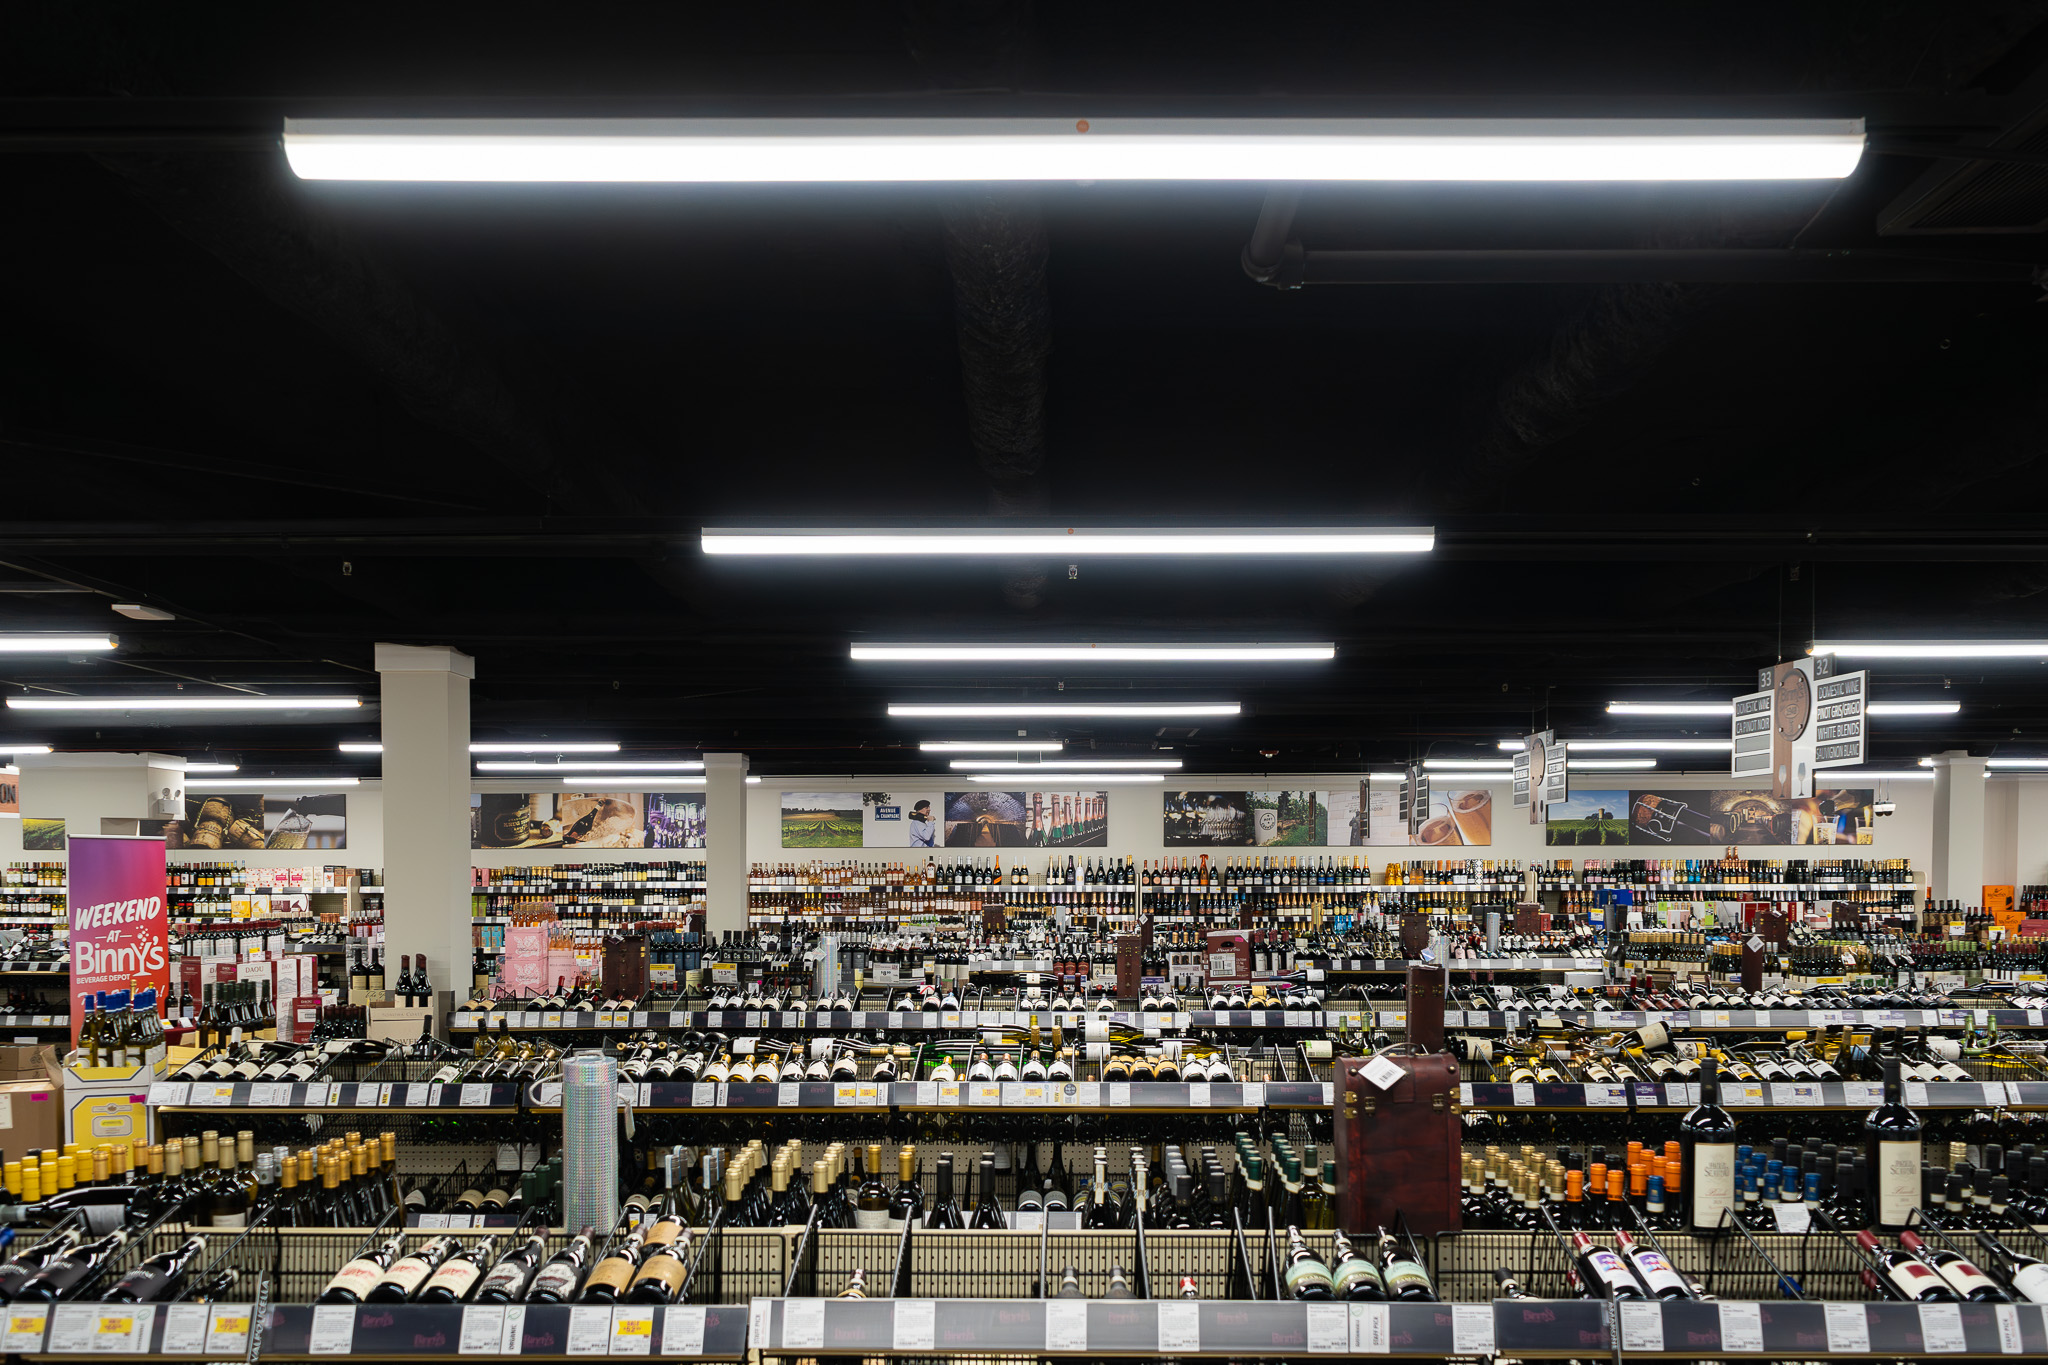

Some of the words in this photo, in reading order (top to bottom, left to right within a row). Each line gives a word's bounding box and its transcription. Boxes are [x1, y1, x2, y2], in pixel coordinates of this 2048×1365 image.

[1816, 658, 1828, 676] 32
[1761, 671, 1771, 688] 33
[1818, 683, 1844, 700] DOMESTIC
[1845, 679, 1860, 694] WINE
[1736, 700, 1758, 715] DOMESTIC
[1758, 697, 1770, 711] WINE
[1817, 704, 1832, 720] PINOT
[1831, 701, 1860, 719] GRIS/GRIGIO
[1743, 719, 1758, 733] PINOT
[1758, 717, 1770, 730] NOIR
[1817, 725, 1836, 741] WHITE
[1837, 722, 1860, 738] BLENDS
[1816, 744, 1843, 760] SAUVIGNON
[1843, 742, 1860, 757] BLANC
[75, 896, 161, 931] WEEKEND
[106, 930, 122, 943] AT
[743, 952, 751, 960] Cs
[245, 965, 264, 974] DAOU
[76, 975, 108, 985] BEVERAGE
[109, 973, 130, 982] DEPOT
[251, 1280, 270, 1362] VALPOLICELLA
[509, 1324, 517, 1351] ORGANIC
